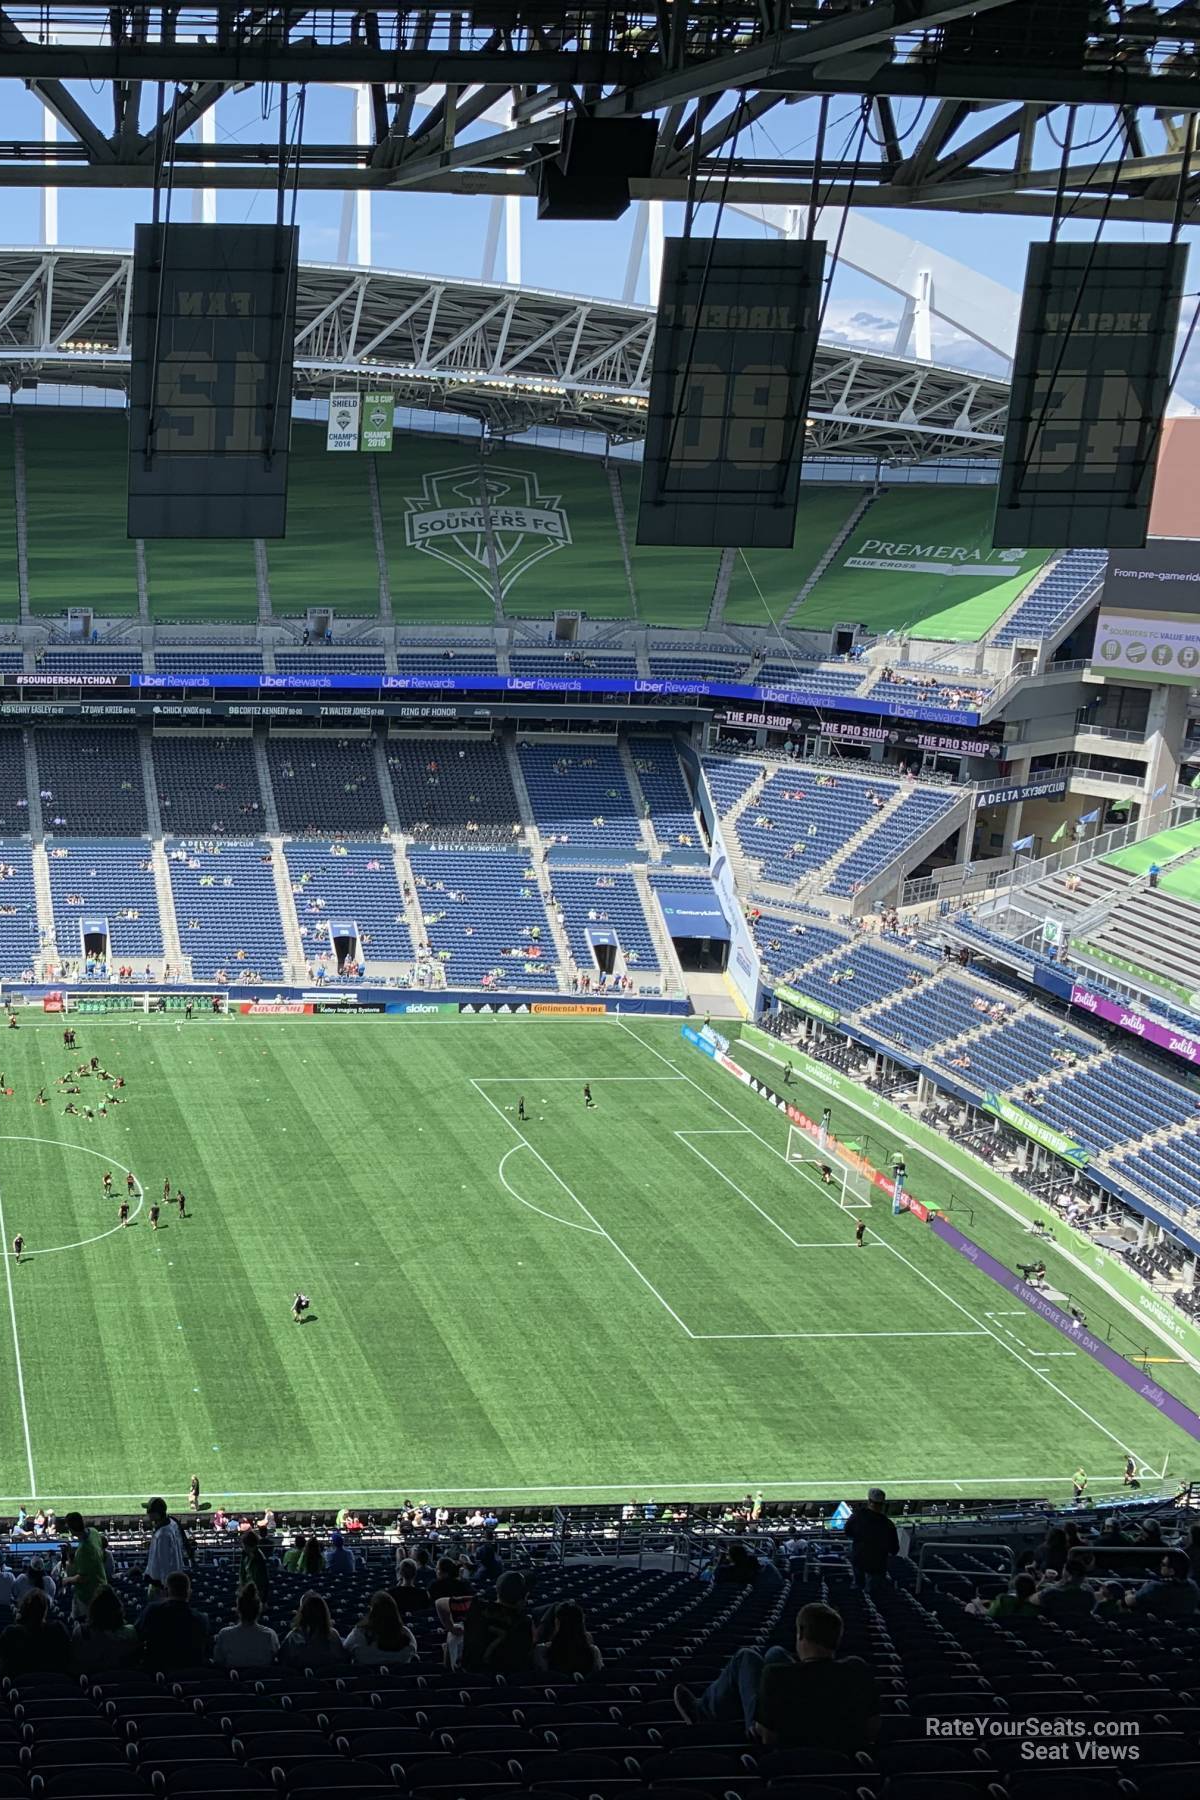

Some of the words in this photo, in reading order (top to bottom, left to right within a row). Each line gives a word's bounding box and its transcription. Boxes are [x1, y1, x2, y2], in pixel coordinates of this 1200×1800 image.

[332, 400, 358, 408] SHIELD
[329, 433, 358, 441] CHAMPS
[532, 518, 560, 533] FC
[858, 539, 981, 560] PREMERA
[849, 559, 877, 567] BLUE
[879, 561, 917, 569] CROSS
[1114, 568, 1138, 578] From
[1160, 631, 1184, 641] VALUE
[16, 676, 118, 685] #SOUNDERSMATCHDAY
[138, 675, 166, 687] Uber
[167, 675, 210, 687] Rewards
[259, 675, 288, 687] Uber
[289, 676, 332, 687] Rewards
[382, 676, 410, 688] Uber
[411, 677, 456, 688] Rewards
[507, 678, 536, 690] Uber
[537, 678, 582, 690] Rewards
[634, 680, 665, 693] Uber
[665, 681, 710, 694] Rewards
[761, 688, 790, 704] Uber
[790, 692, 836, 708] Rewards
[81, 706, 90, 714] 17
[162, 706, 182, 714] CHUCK
[182, 706, 199, 714] KNOX
[239, 706, 261, 715] CORTEZ
[262, 706, 289, 715] KENNEDY
[329, 707, 352, 715] WALTER
[352, 707, 371, 715] JONES
[401, 708, 420, 716] RING
[421, 708, 430, 716] OF
[431, 708, 457, 716] HONOR
[889, 703, 919, 719] Uber
[919, 707, 968, 725] Rewards
[726, 711, 743, 723] THE
[745, 713, 765, 726] PRO
[765, 715, 792, 728] SHOP
[820, 721, 839, 734] THE
[840, 723, 861, 737] PRO
[862, 726, 889, 740] SHOP
[917, 734, 937, 747] THE
[938, 736, 960, 750] PRO
[961, 739, 989, 754] SHOP
[988, 789, 1019, 805] DELTA
[405, 1004, 439, 1013] slalom
[534, 1004, 578, 1013] Continental
[1013, 1283, 1020, 1292] A
[1020, 1288, 1039, 1305] NEW
[1036, 1301, 1060, 1323] STORE
[1060, 1319, 1083, 1340] EVERY
[1082, 1336, 1100, 1353] DAY
[1139, 1295, 1175, 1329] SOUNDERS
[1173, 1326, 1187, 1340] FC
